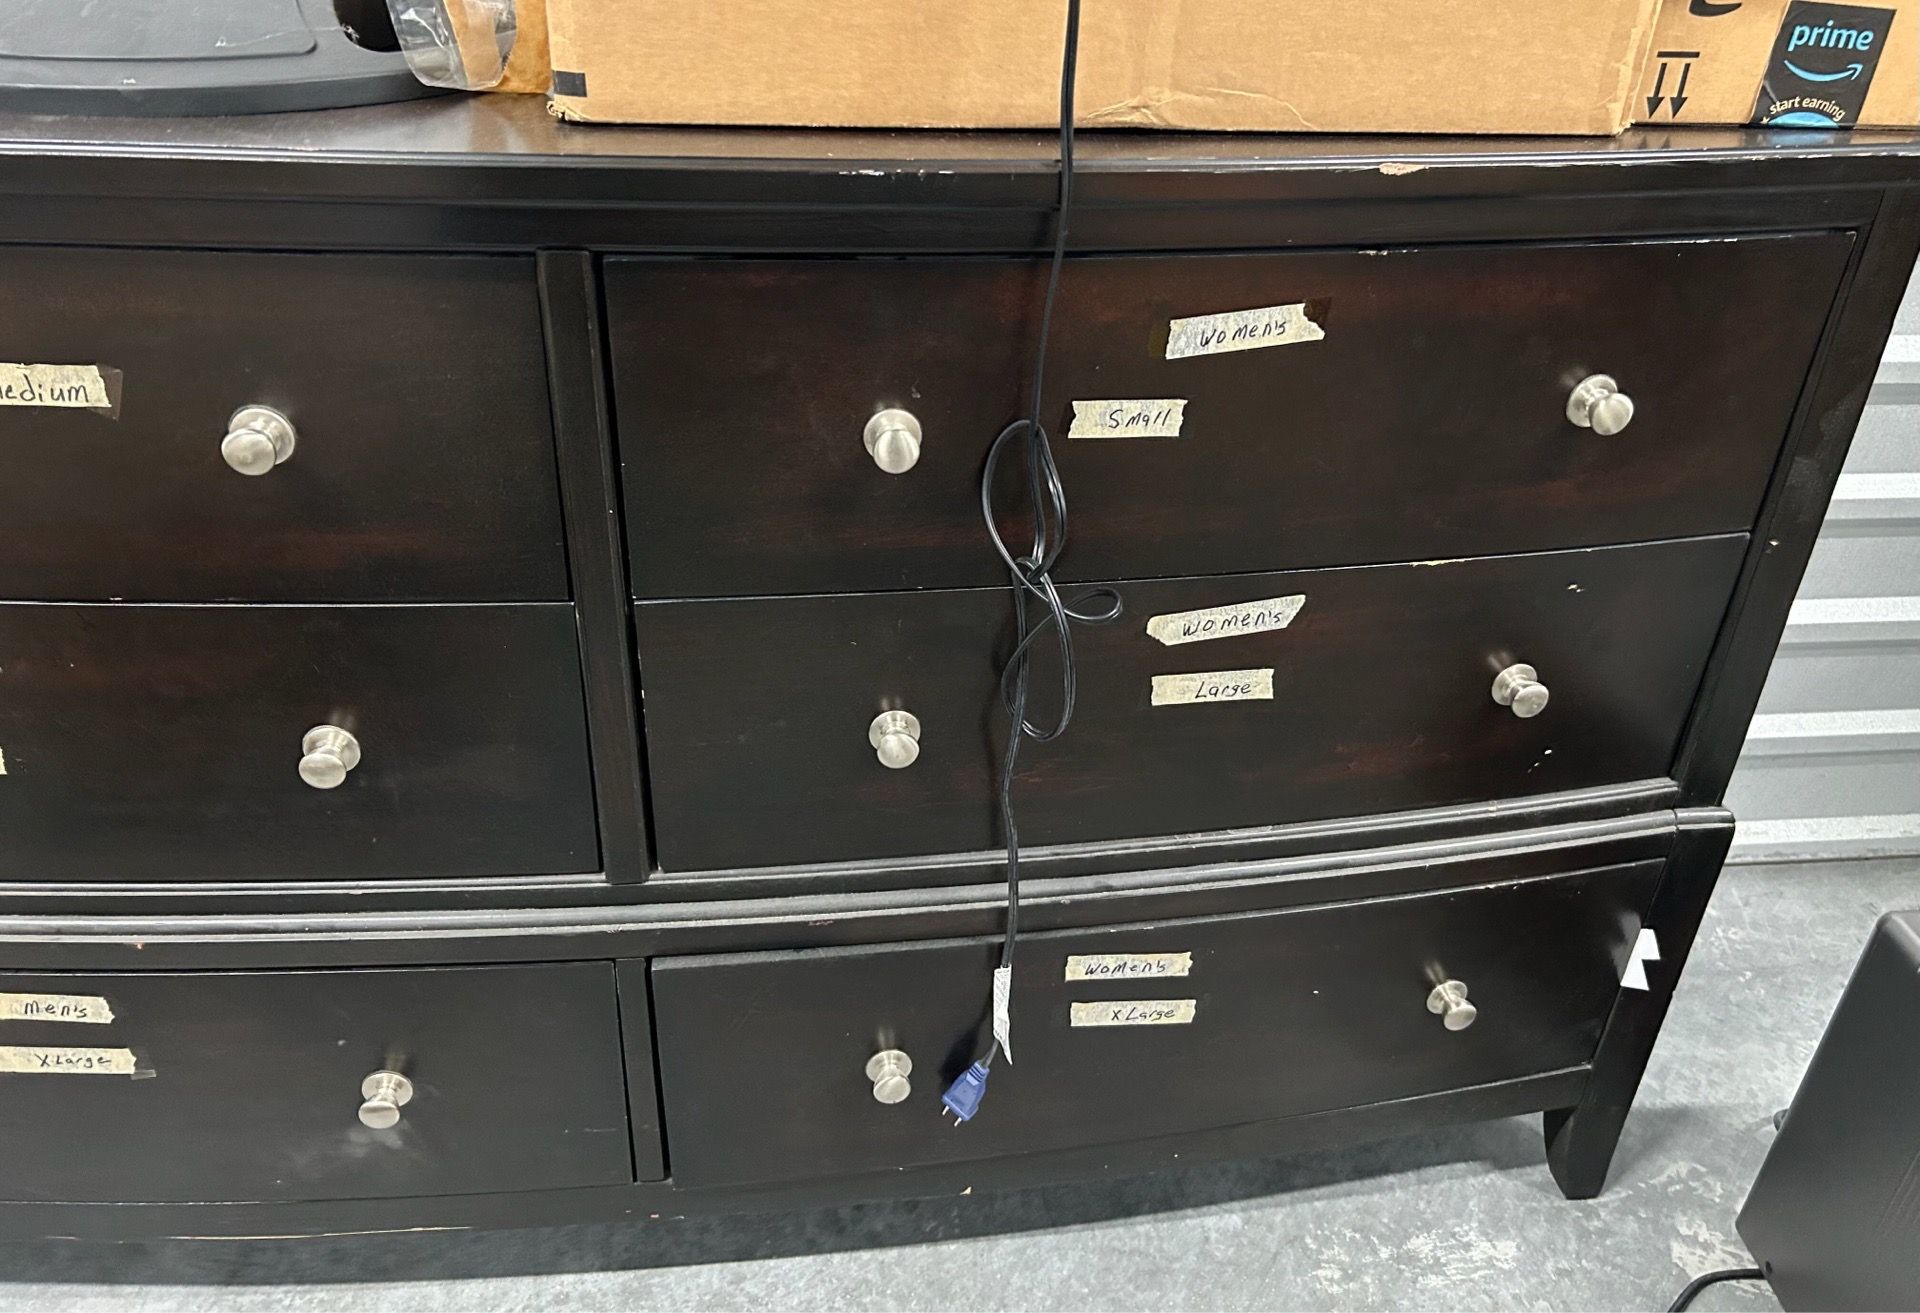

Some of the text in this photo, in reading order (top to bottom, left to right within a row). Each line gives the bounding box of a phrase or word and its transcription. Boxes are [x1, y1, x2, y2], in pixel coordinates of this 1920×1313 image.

[1787, 20, 1874, 52] prime
[1769, 96, 1846, 121] start earning
[1195, 680, 1253, 700] Large
